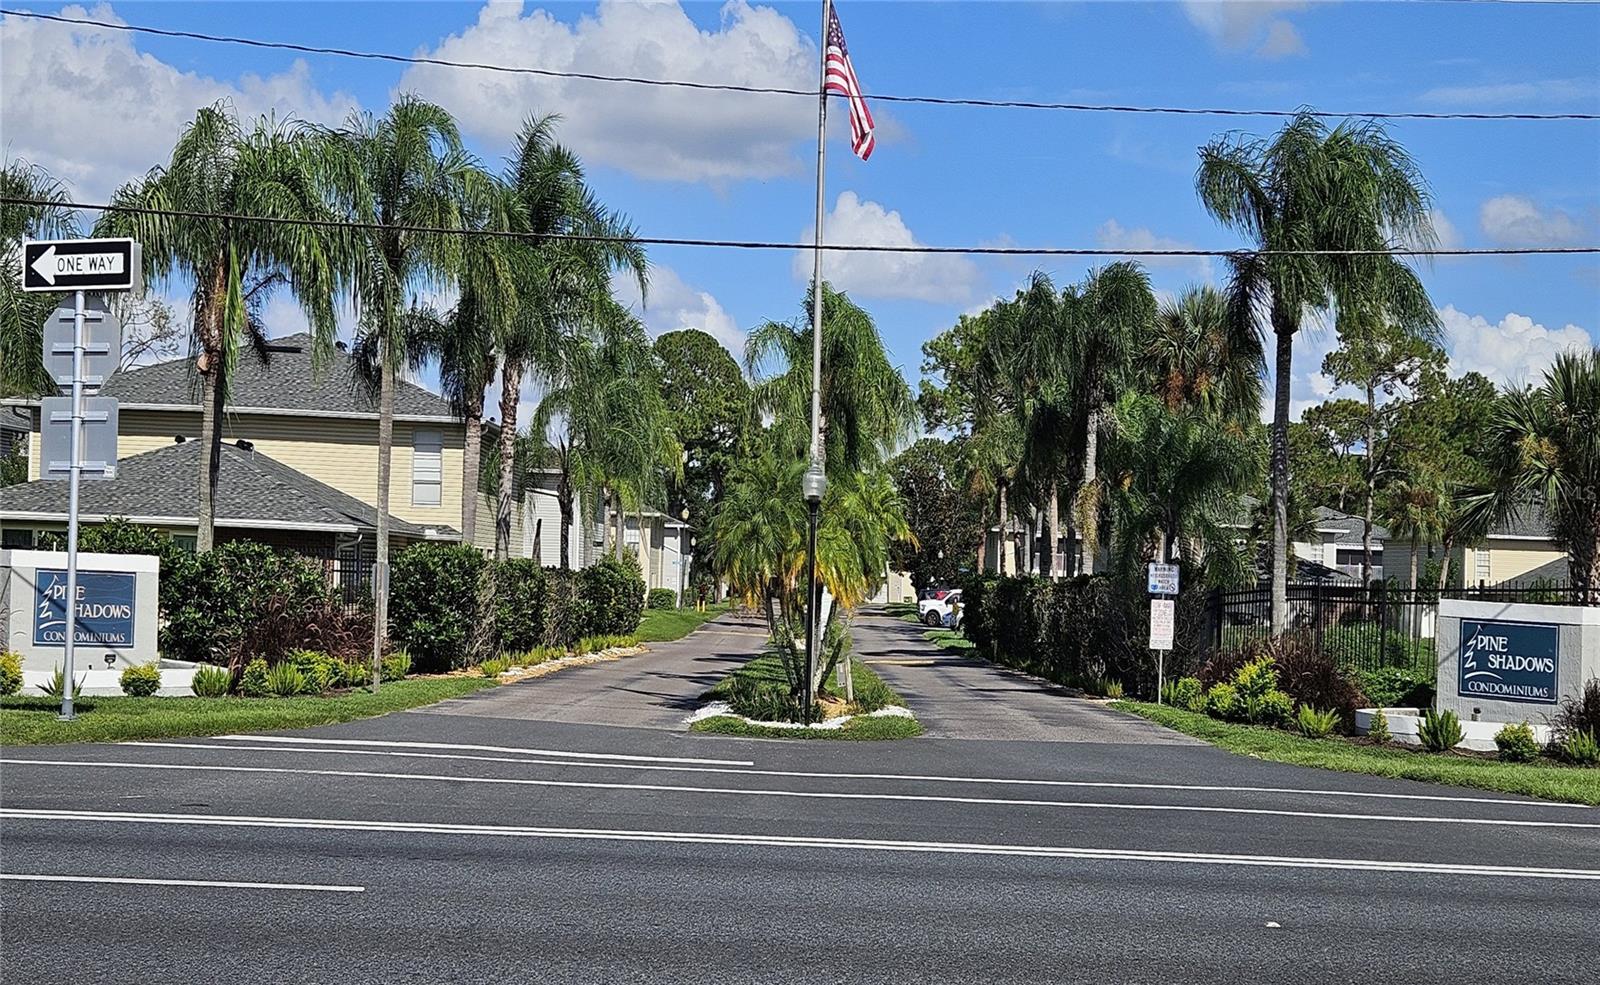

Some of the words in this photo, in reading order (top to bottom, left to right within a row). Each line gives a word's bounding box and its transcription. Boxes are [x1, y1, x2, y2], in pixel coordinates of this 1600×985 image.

[57, 257, 83, 273] ONE
[88, 256, 115, 271] WAY
[53, 585, 86, 600] PIE
[74, 603, 131, 619] HADOWS
[43, 630, 125, 643] CONOMINIUMS
[1477, 635, 1508, 652] PINE
[1488, 654, 1554, 673] SHADOWS
[1468, 681, 1549, 697] CONDOMINIUMS
